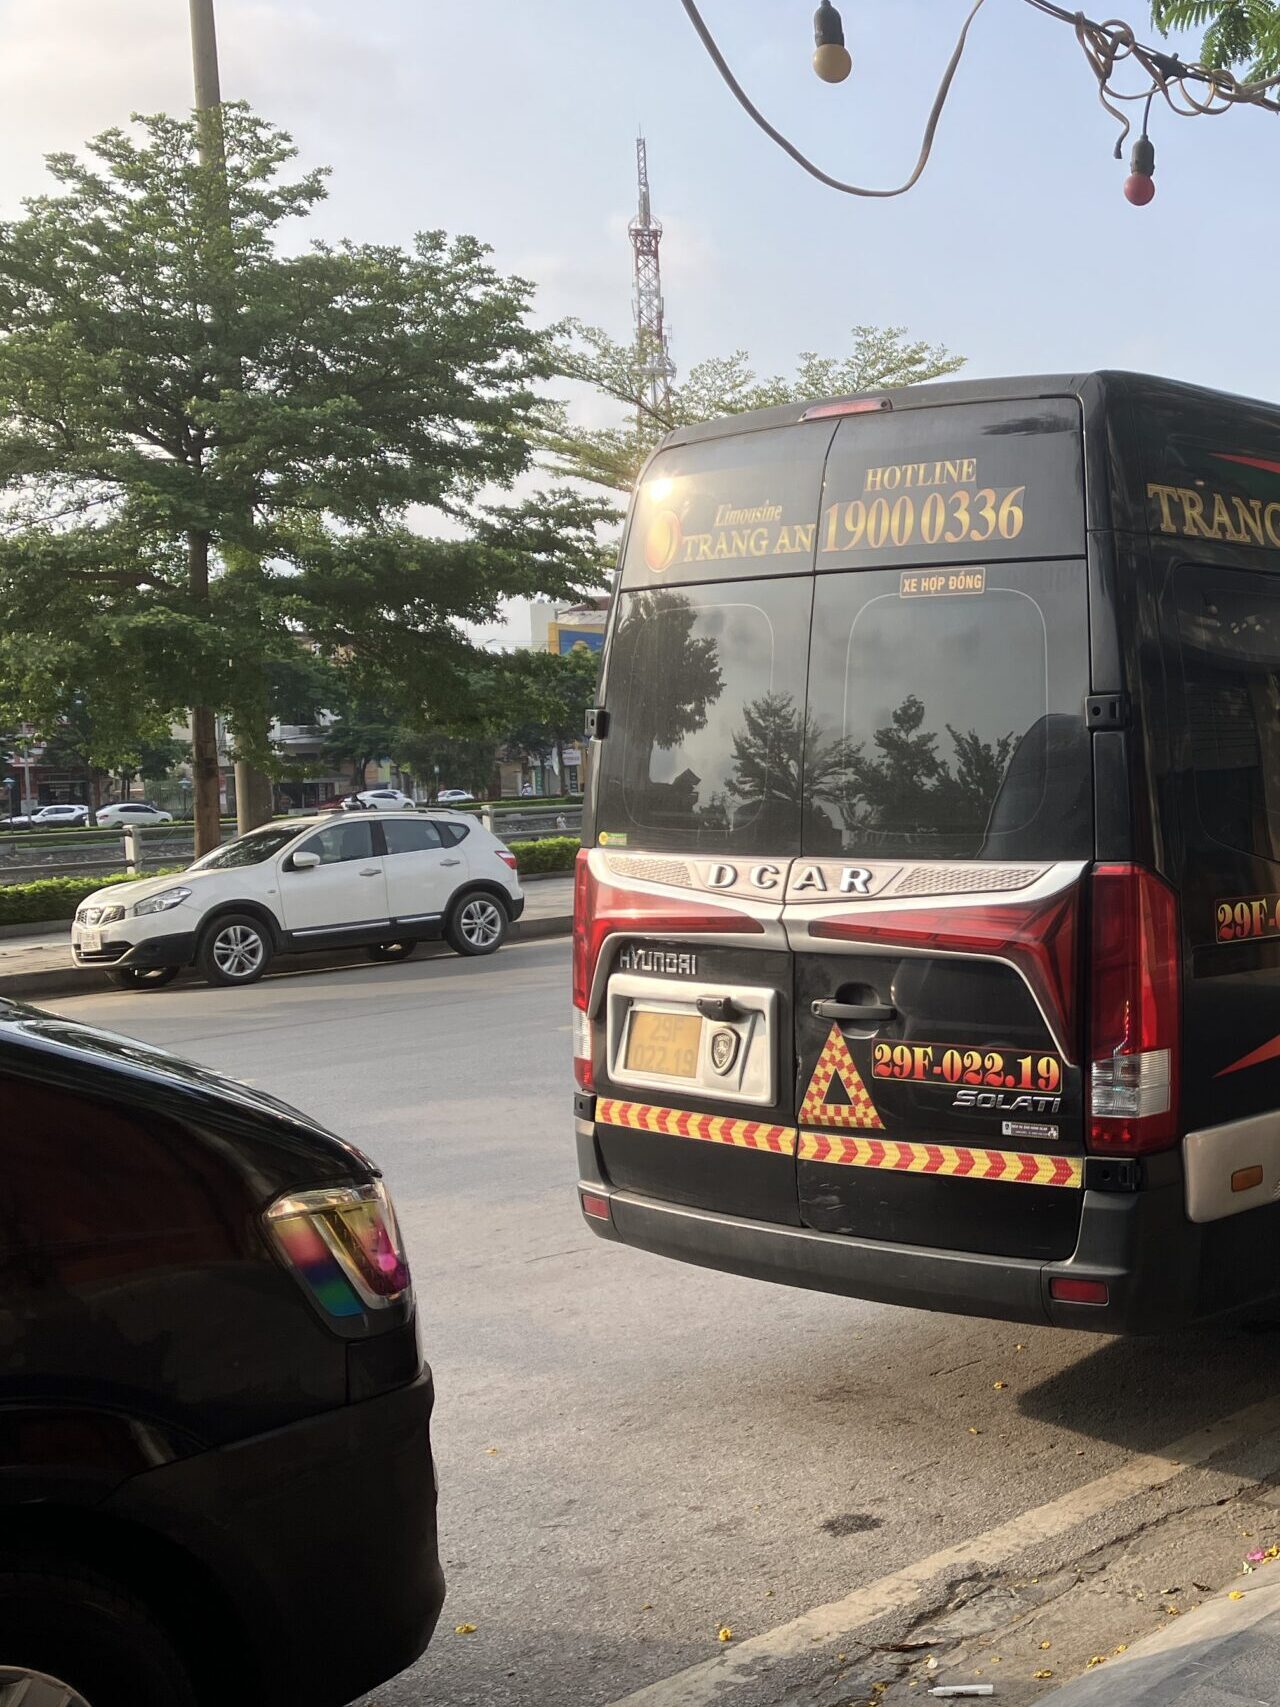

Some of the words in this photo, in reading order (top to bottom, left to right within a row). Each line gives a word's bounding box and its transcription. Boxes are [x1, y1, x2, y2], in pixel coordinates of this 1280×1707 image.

[864, 458, 977, 491] HOTLINE
[714, 499, 783, 527] Limousine
[822, 498, 914, 552] 1900
[920, 486, 1026, 544] 0336
[682, 527, 770, 562] TRANG
[774, 523, 816, 553] AN
[903, 578, 917, 593] XE
[921, 575, 945, 595] HỢP
[706, 862, 873, 894] DCAR
[619, 946, 697, 975] HYUNDAI
[874, 1043, 1060, 1091] 29F-022.19
[952, 1089, 1061, 1114] SOLATI
